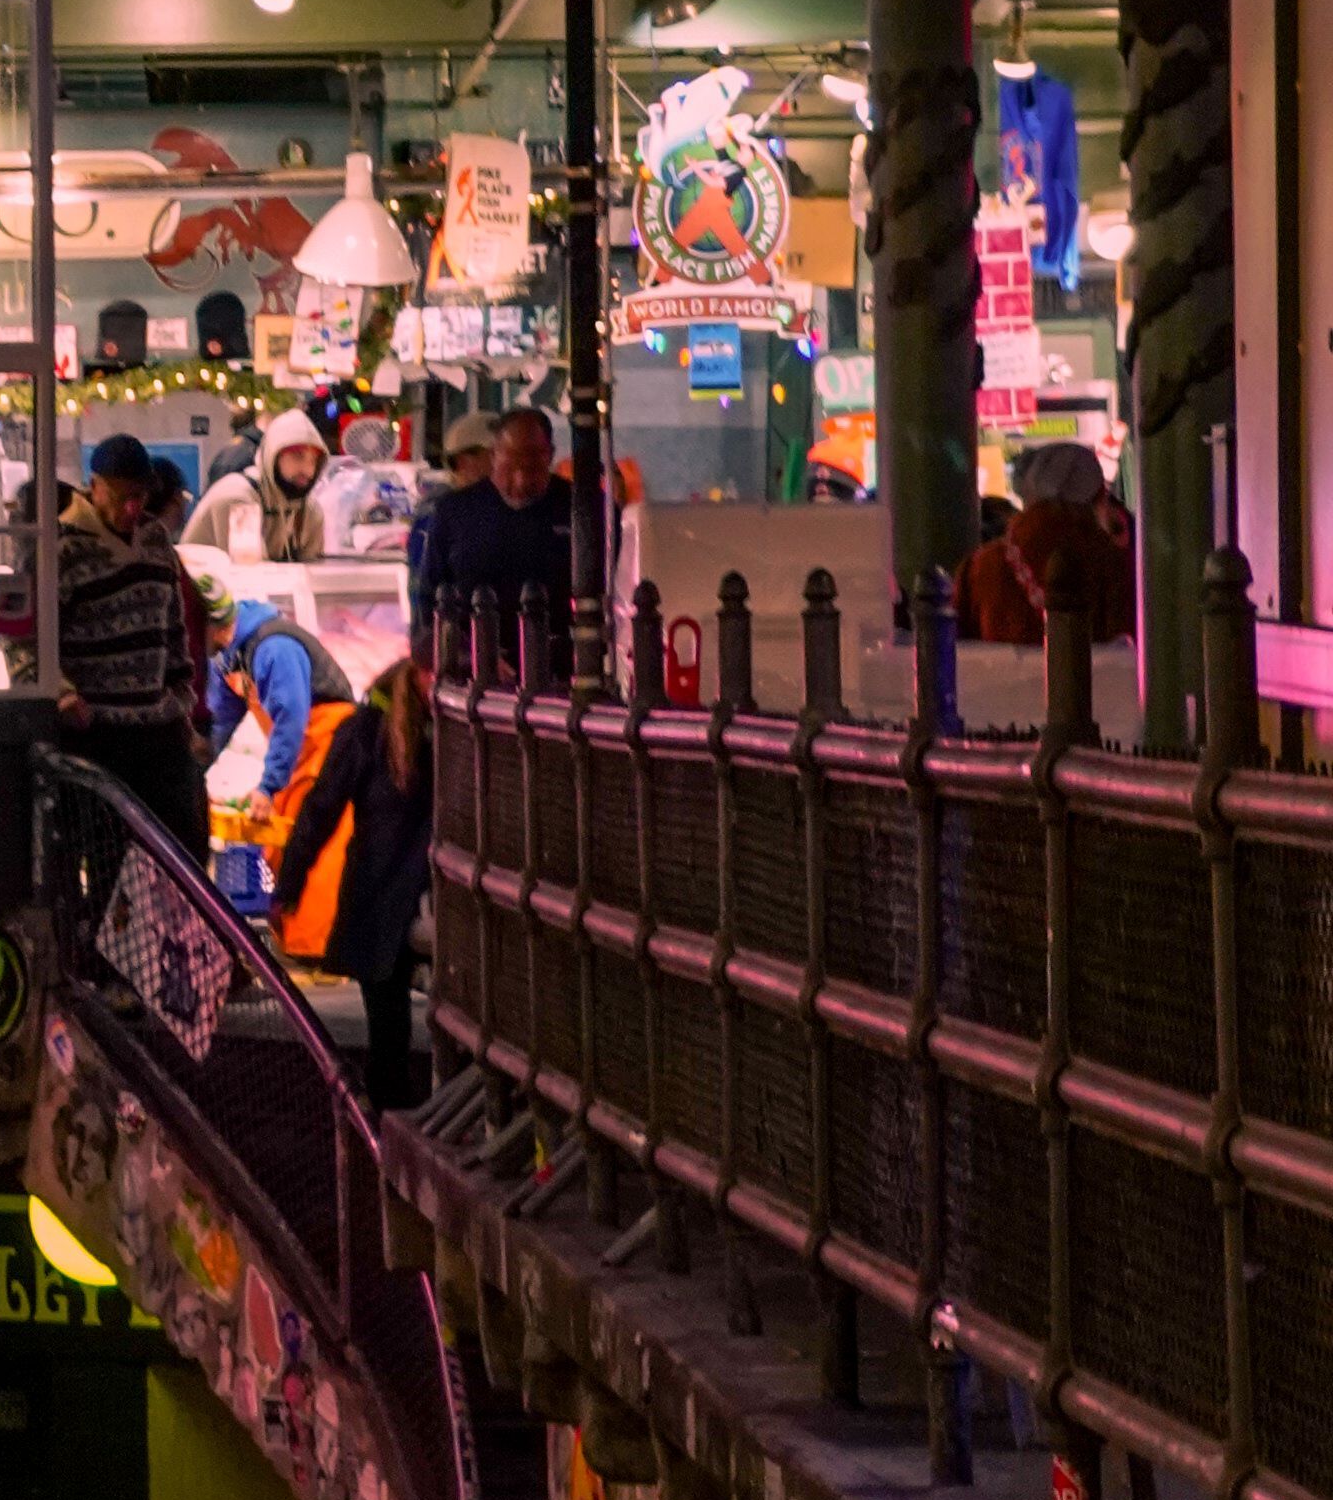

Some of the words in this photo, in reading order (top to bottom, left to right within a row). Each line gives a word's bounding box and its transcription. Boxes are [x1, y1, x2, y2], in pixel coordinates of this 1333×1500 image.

[753, 166, 782, 256] MARKET
[632, 298, 704, 320] WORLD
[709, 297, 789, 319] FAMOU
